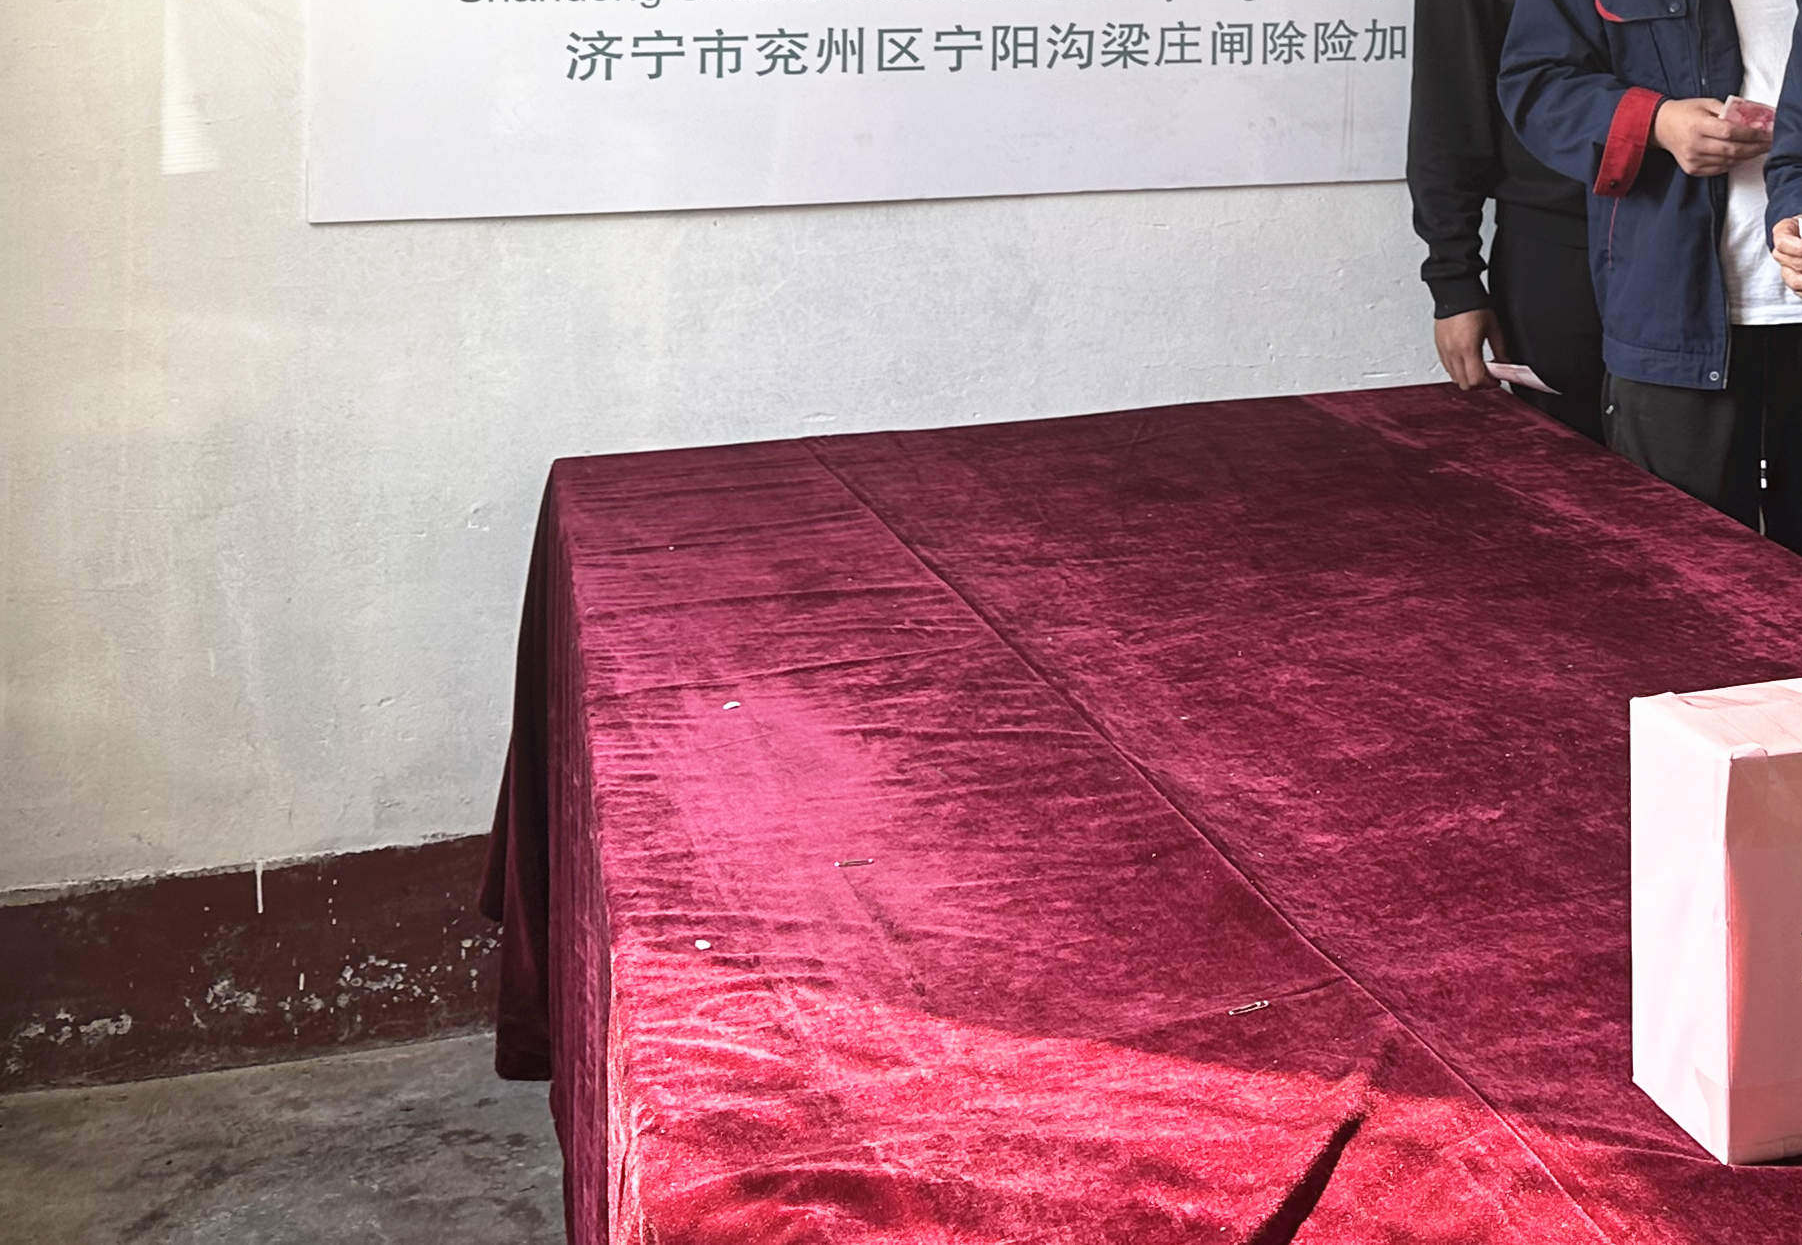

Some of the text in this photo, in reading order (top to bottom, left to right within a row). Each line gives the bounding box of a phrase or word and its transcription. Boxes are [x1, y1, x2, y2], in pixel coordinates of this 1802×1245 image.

[565, 18, 1407, 82] 济宁市兖州区宁阳沟梁庄闸除险加
